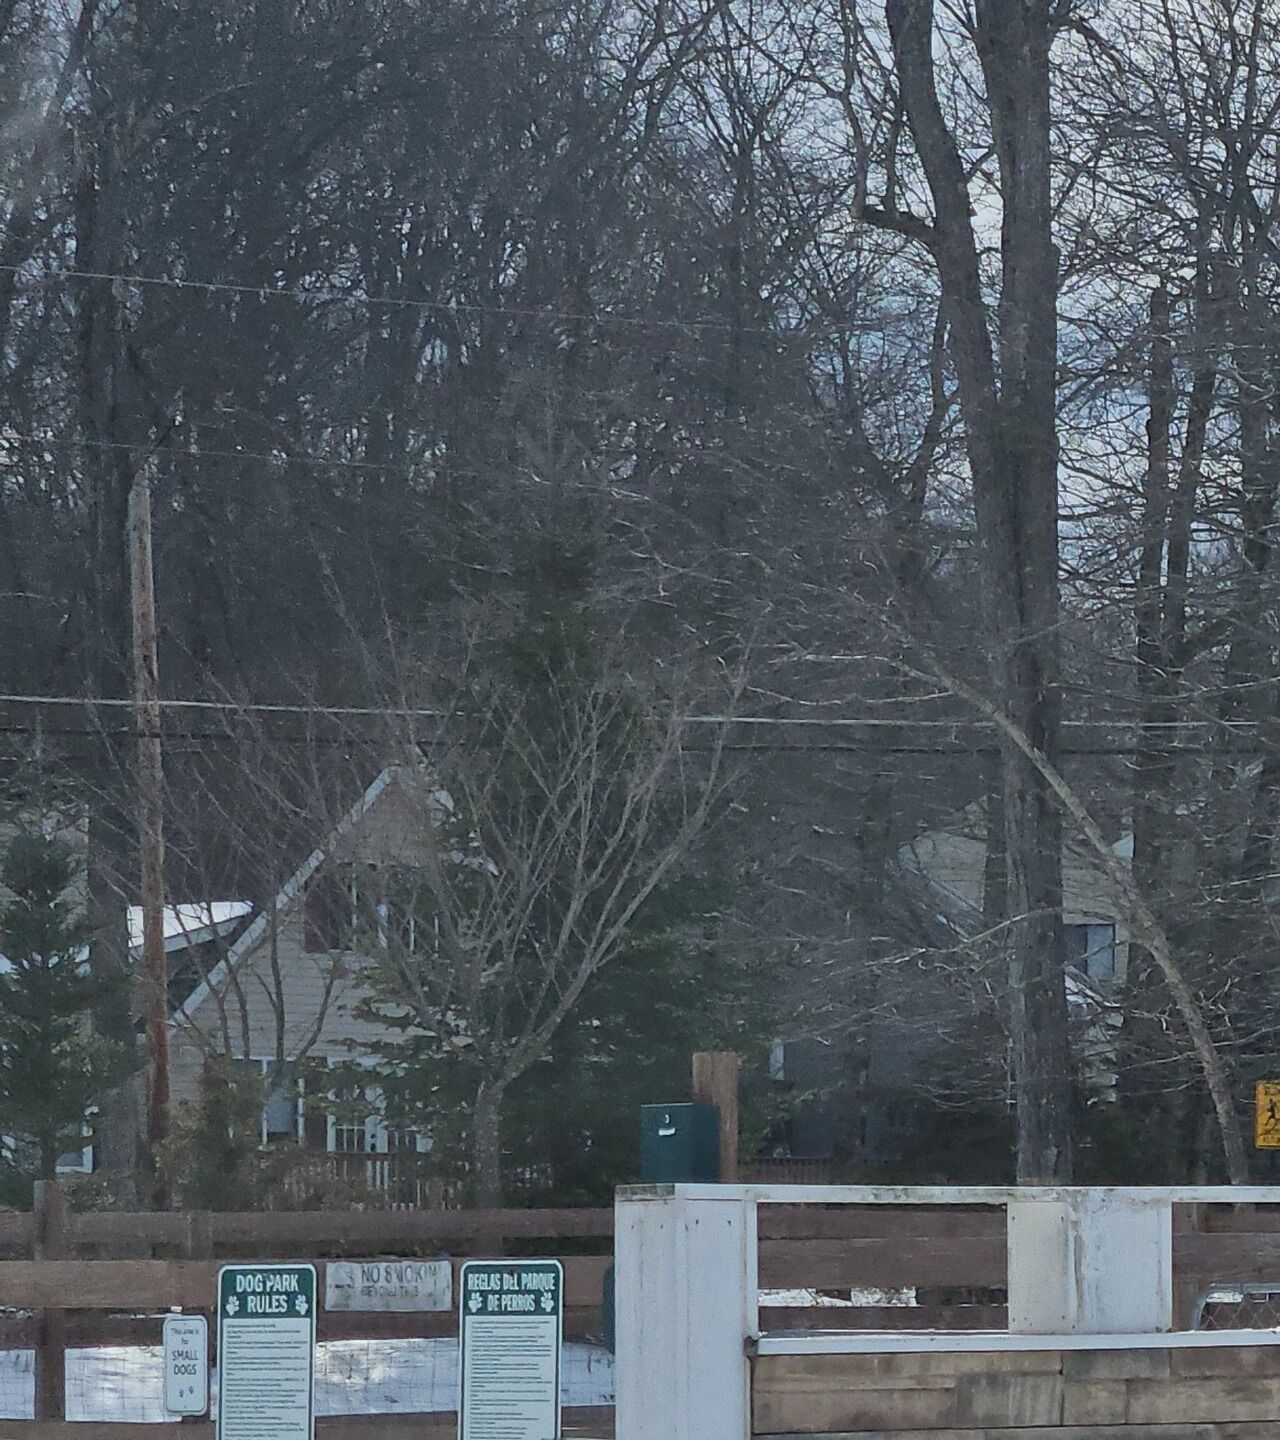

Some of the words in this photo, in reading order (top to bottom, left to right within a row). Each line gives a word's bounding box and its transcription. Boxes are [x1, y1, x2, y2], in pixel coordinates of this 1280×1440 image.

[361, 1264, 380, 1283] NO
[468, 1273, 501, 1290] REGLAS
[502, 1273, 520, 1290] DEL
[521, 1273, 556, 1292] PARQUE
[236, 1274, 263, 1292] DOG
[265, 1274, 299, 1292] PARK
[247, 1294, 288, 1313] RULES
[487, 1294, 500, 1311] DE
[501, 1294, 536, 1312] PERROS
[172, 1350, 198, 1361] SMALL
[174, 1364, 197, 1375] DOGS
